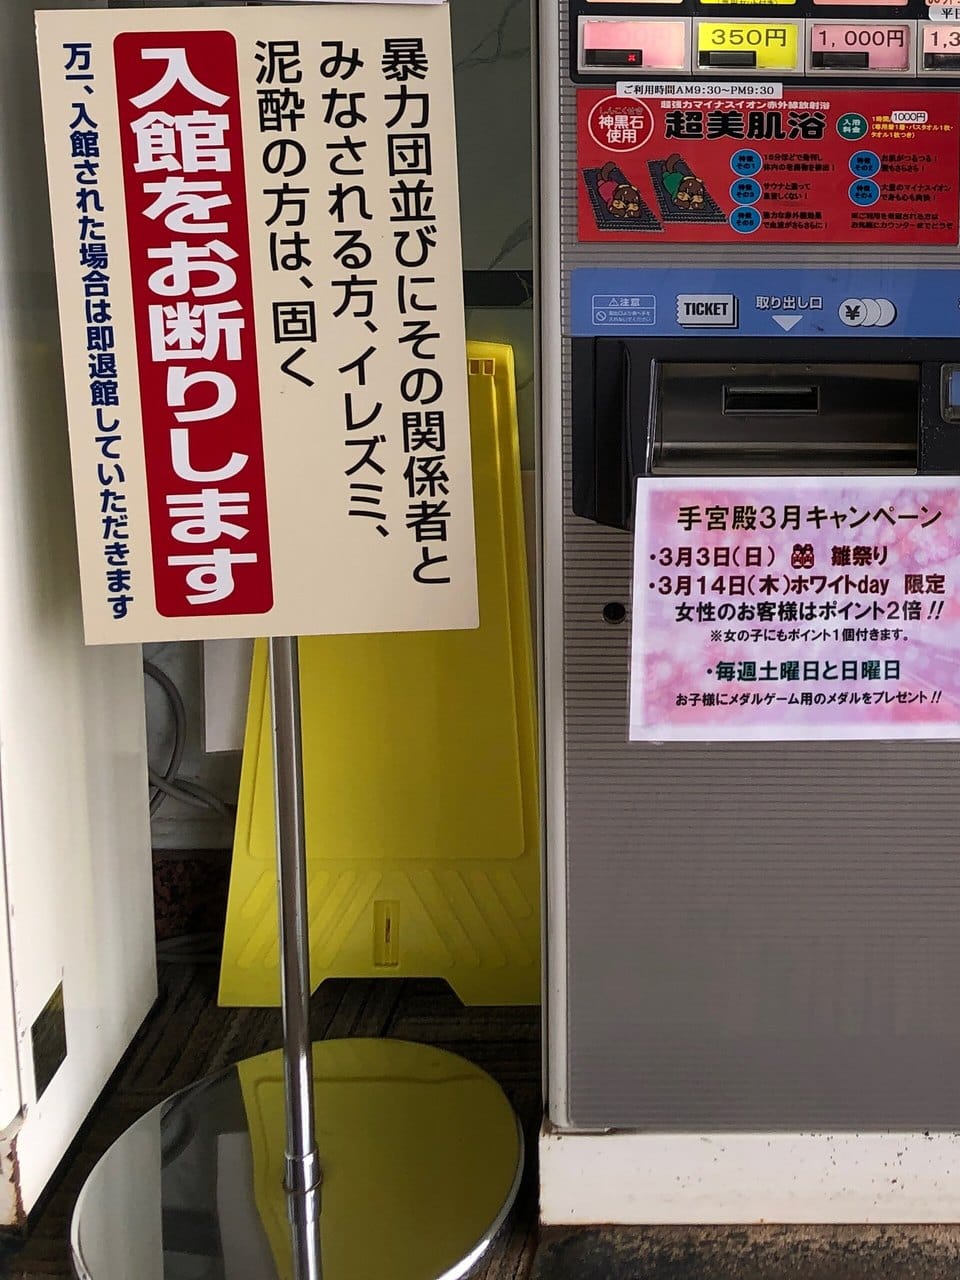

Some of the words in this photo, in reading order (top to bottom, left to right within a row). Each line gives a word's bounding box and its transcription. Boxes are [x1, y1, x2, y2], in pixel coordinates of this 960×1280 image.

[711, 28, 788, 48] 350円
[599, 114, 645, 130] 神黒石
[664, 110, 828, 141] 超美肌浴
[893, 111, 926, 122] 1000円
[606, 129, 638, 145] 使用
[253, 40, 319, 387] 泥酔の方は、固く
[379, 36, 452, 586] 暴力団並びにその関係者と
[683, 302, 729, 316] TICKET
[755, 294, 823, 311] 取り出し口
[61, 42, 134, 620] 万一、入館された場合は即退館していただきます
[129, 47, 259, 606] 入館をお断りします
[677, 504, 943, 531] 手宮殿3月キャンペーン
[830, 546, 889, 566] 雛祭り
[903, 573, 946, 595] 限定
